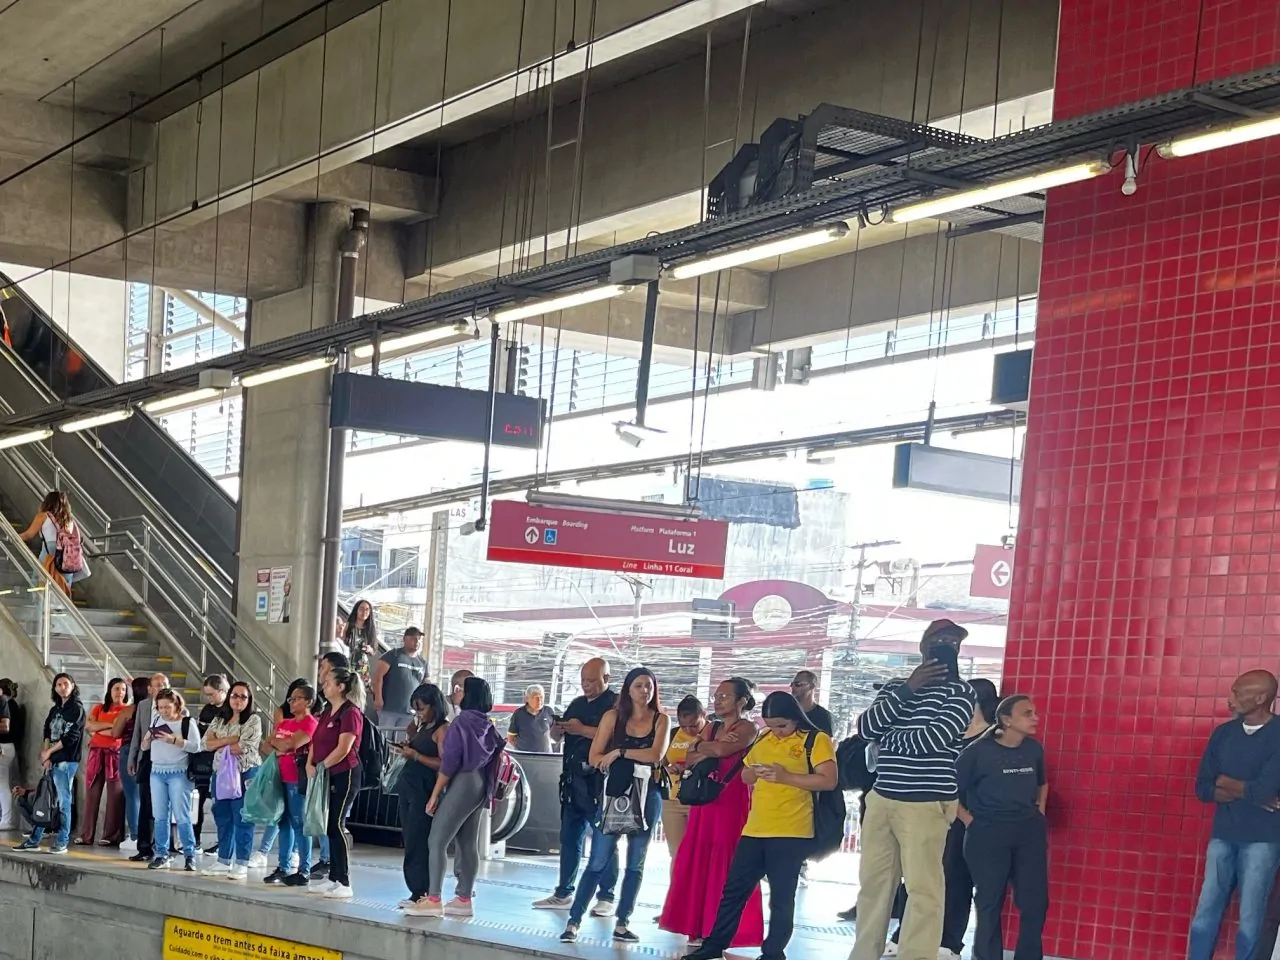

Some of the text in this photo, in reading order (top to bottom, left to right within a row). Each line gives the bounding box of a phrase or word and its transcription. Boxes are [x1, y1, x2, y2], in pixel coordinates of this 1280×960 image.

[526, 516, 589, 530] Embarque Boarding
[630, 525, 655, 534] Platform
[658, 527, 692, 537] Plataforma
[668, 538, 695, 555] Luz
[622, 561, 694, 574] Line Linha 11 Coral
[174, 925, 204, 940] Aguarde
[206, 934, 211, 942] o
[214, 934, 231, 945] trem
[234, 939, 255, 951] antes
[257, 943, 268, 955] da
[270, 945, 290, 959] faixa
[169, 944, 191, 956] Cuidado
[191, 949, 203, 959] com
